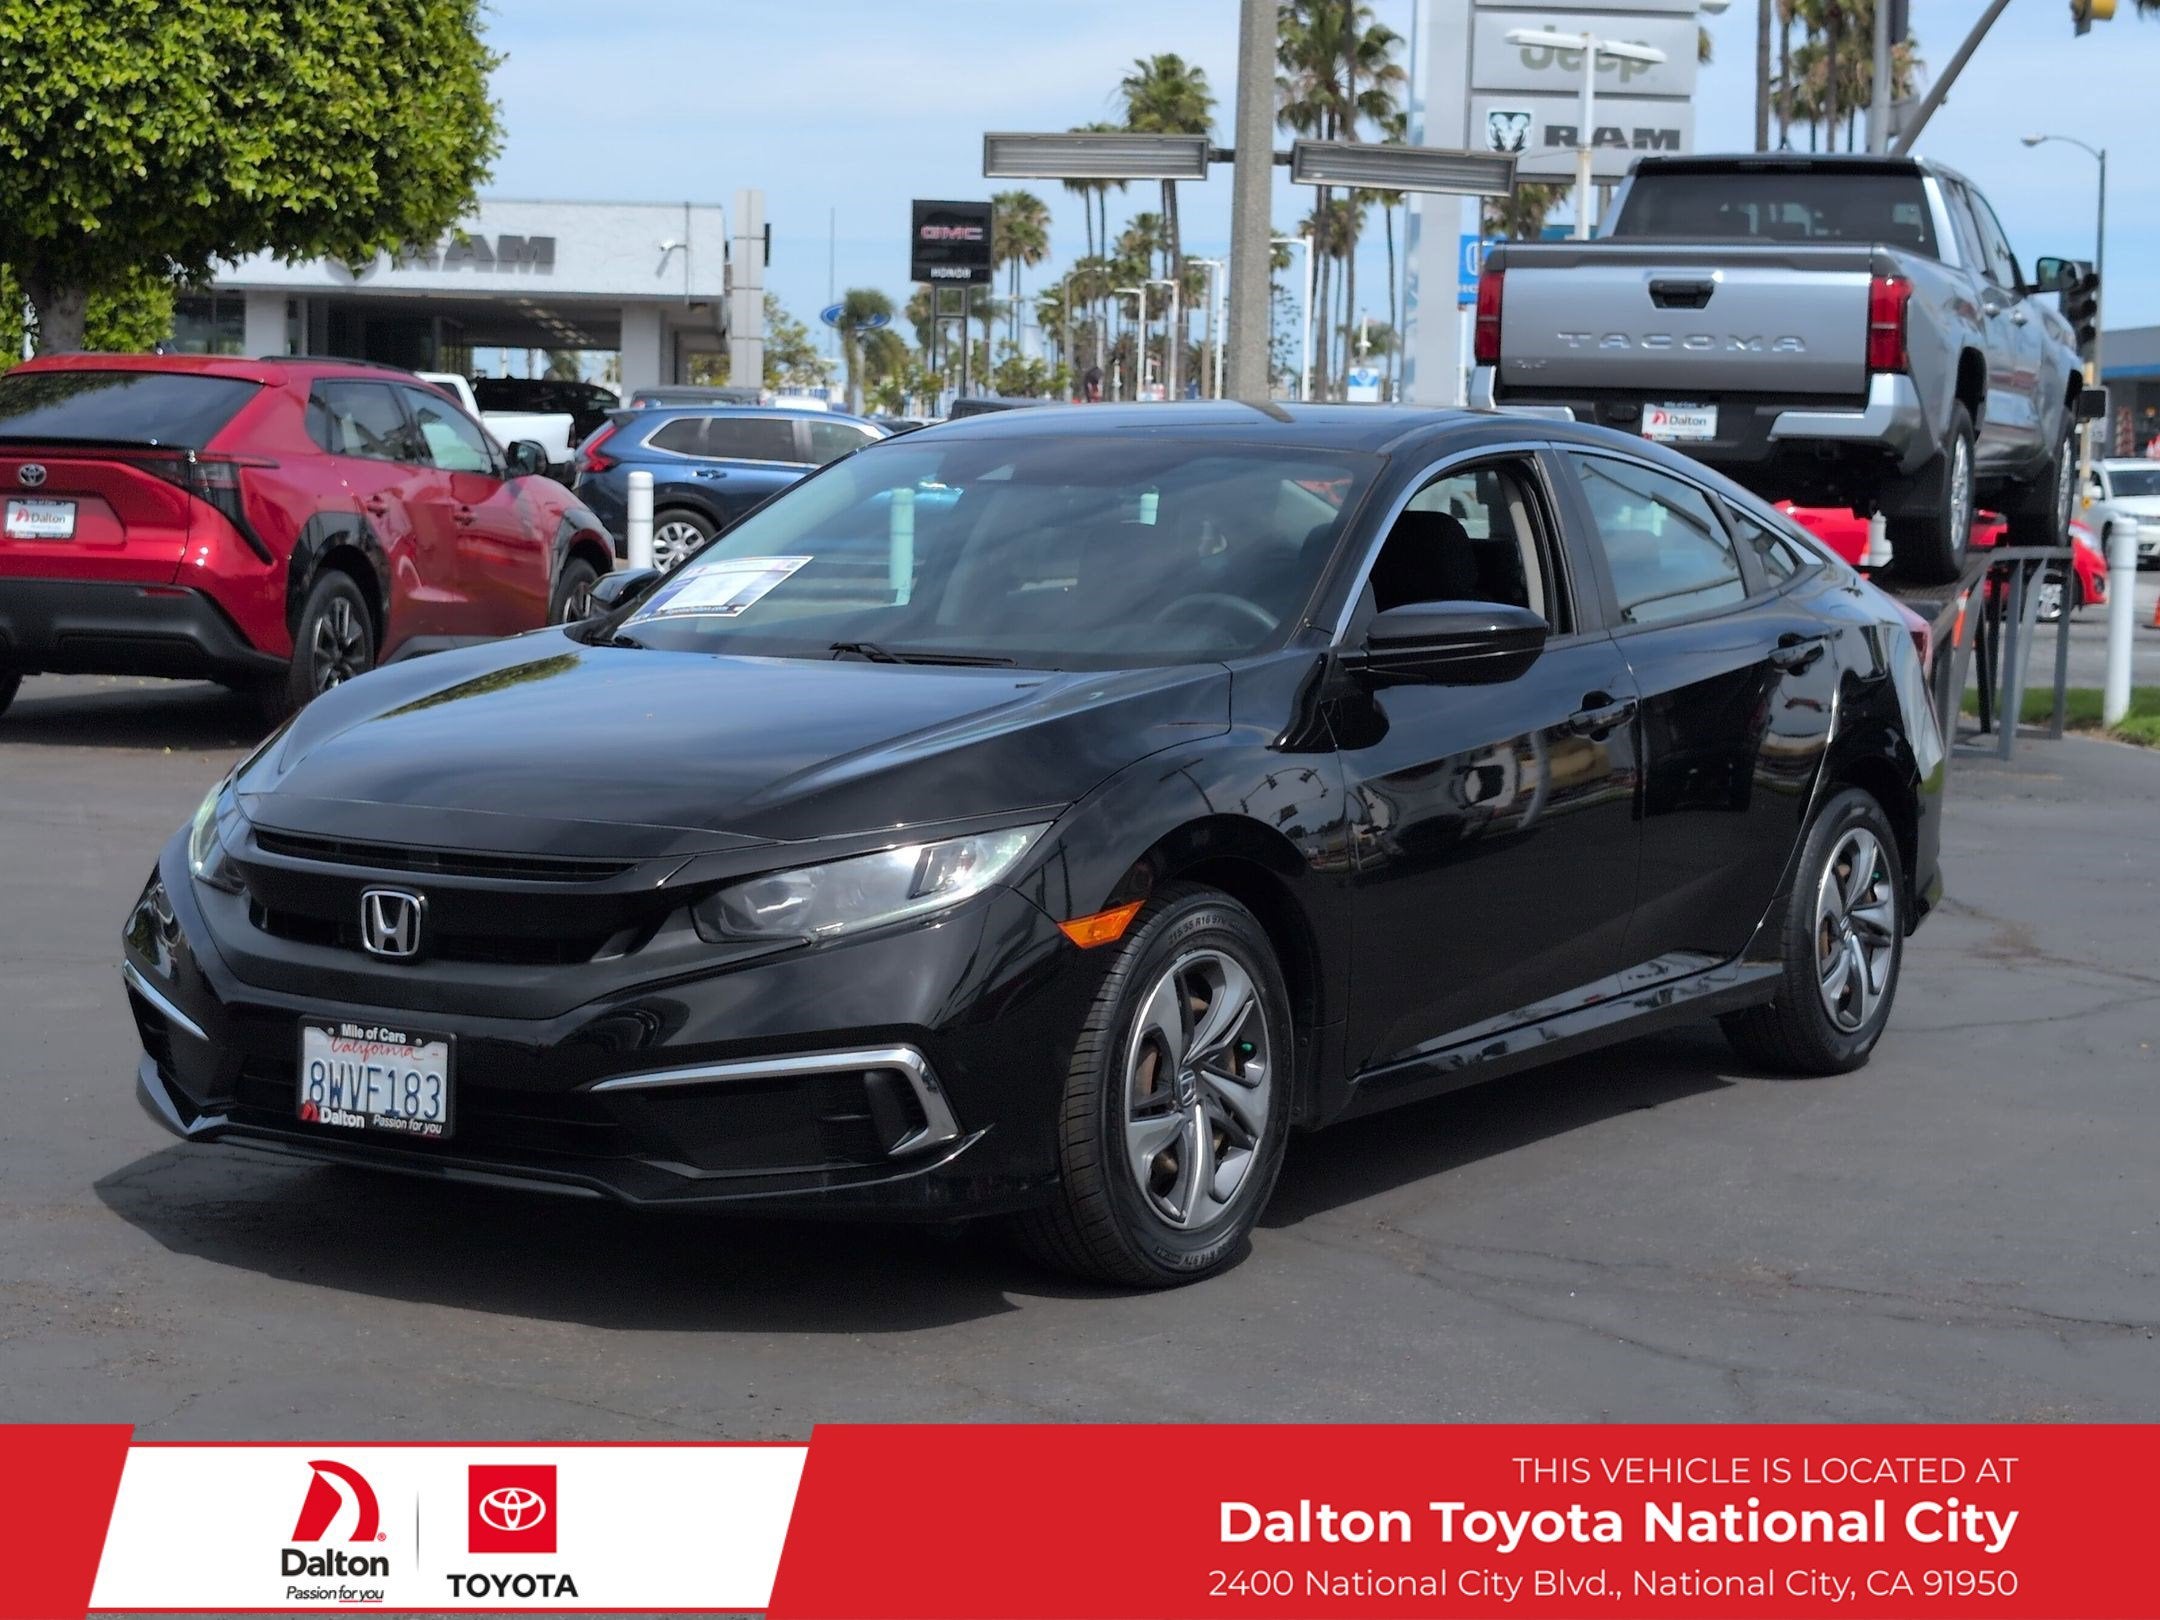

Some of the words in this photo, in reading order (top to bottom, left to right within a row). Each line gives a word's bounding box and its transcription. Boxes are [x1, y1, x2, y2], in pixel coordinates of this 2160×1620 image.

[1544, 125, 1681, 150] RAM
[921, 225, 983, 240] GMC
[1557, 331, 1806, 352] TACOMA
[1669, 413, 1707, 425] Dalton
[31, 511, 66, 523] Dalton
[341, 1023, 364, 1039] Mile
[366, 1026, 379, 1041] of
[380, 1028, 407, 1043] Cars
[331, 1036, 424, 1062] California
[309, 1059, 442, 1120] 8WVF183
[320, 1107, 365, 1128] Dalton
[373, 1115, 407, 1130] Passion
[409, 1119, 423, 1132] for
[424, 1122, 443, 1135] you
